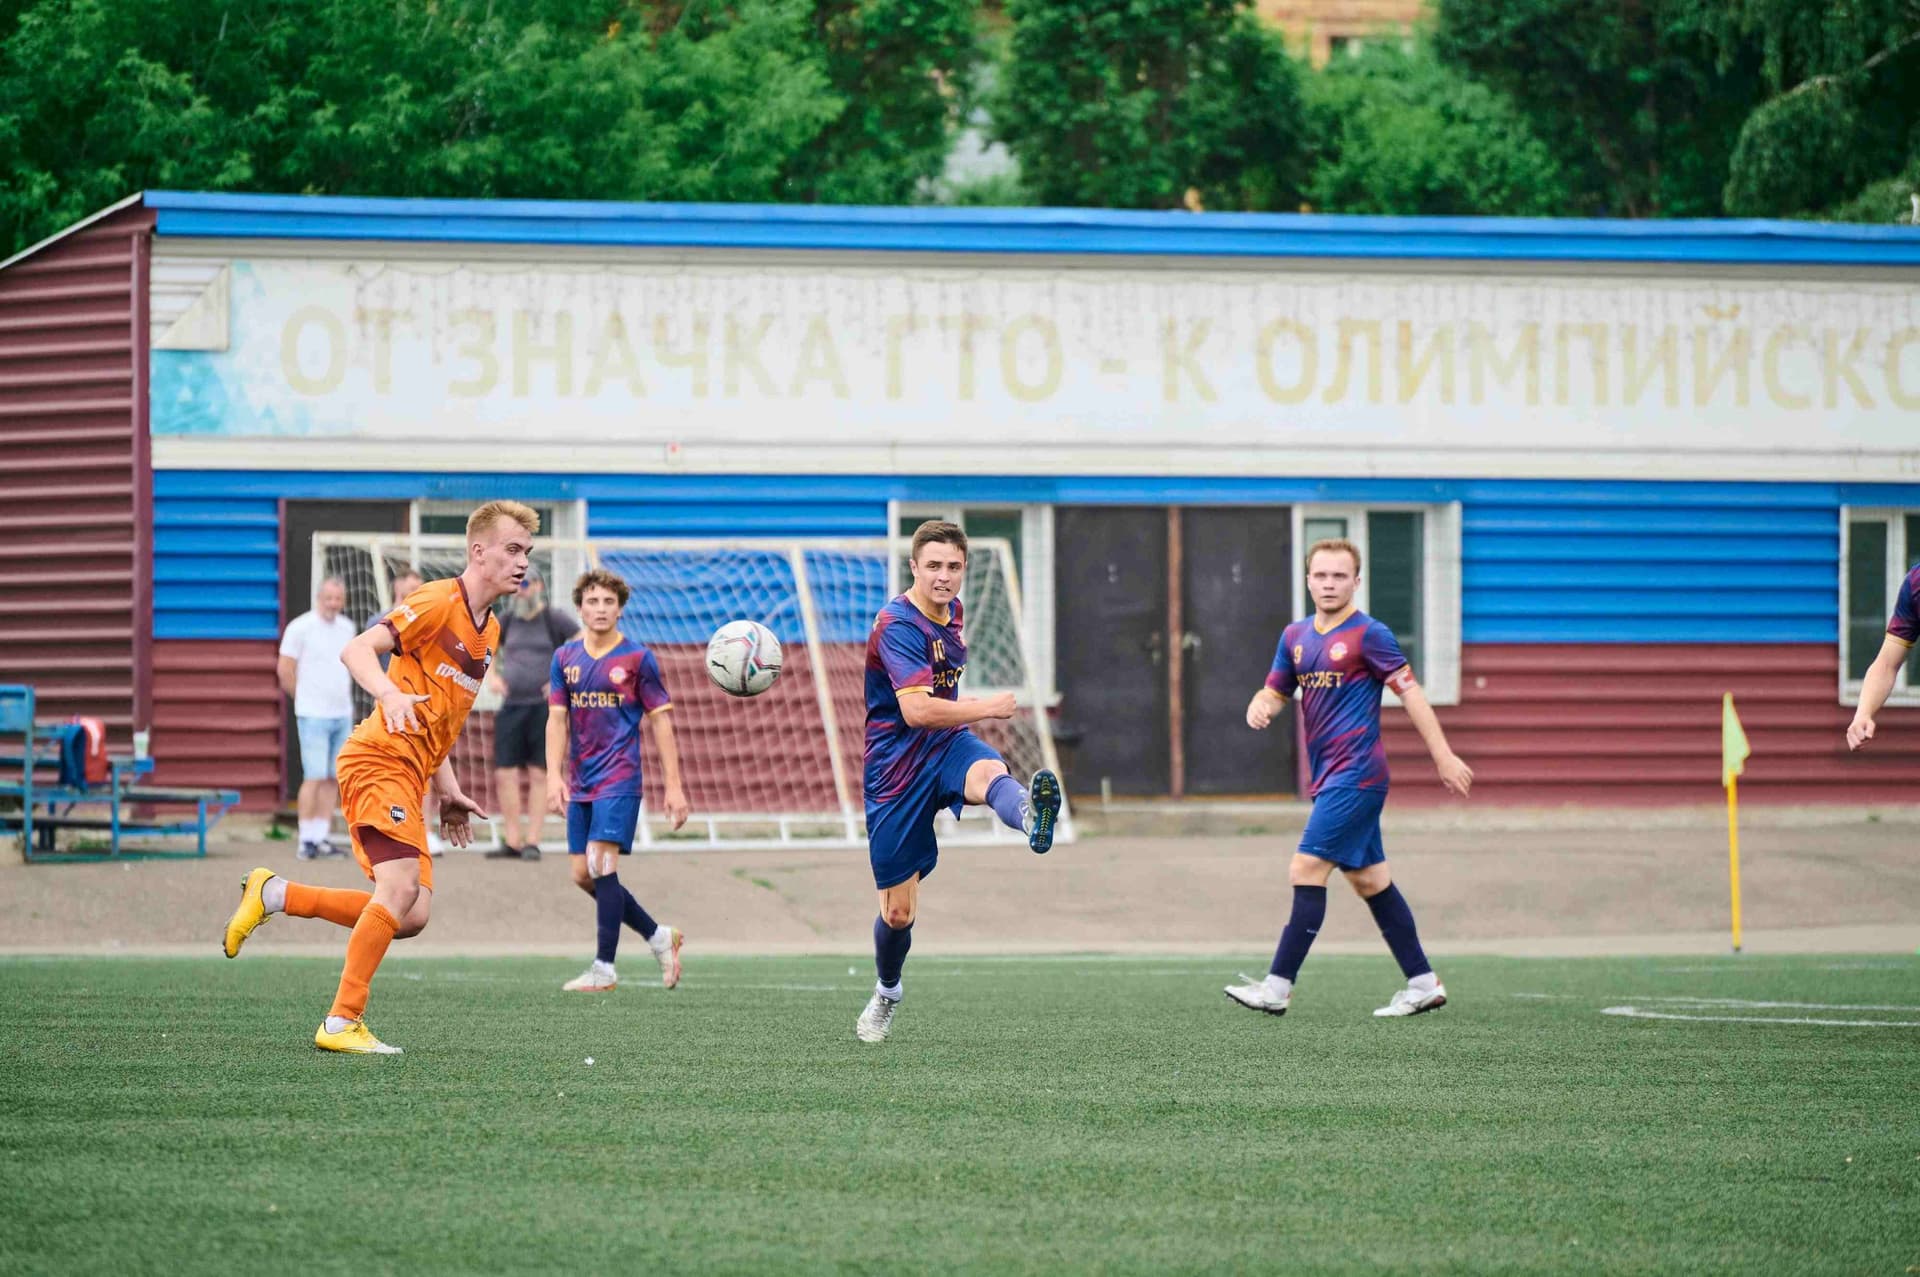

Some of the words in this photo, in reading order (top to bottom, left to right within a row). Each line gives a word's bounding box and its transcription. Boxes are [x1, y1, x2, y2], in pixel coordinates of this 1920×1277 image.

[280, 306, 412, 397] ОТ
[448, 308, 850, 400] ЗНАЧКА
[884, 312, 1063, 403] ГТО
[1161, 315, 1218, 404] К
[1255, 304, 1920, 411] ОЛИМПИЙСКО
[1294, 645, 1303, 664] 9
[570, 692, 625, 708] АССВЕТ
